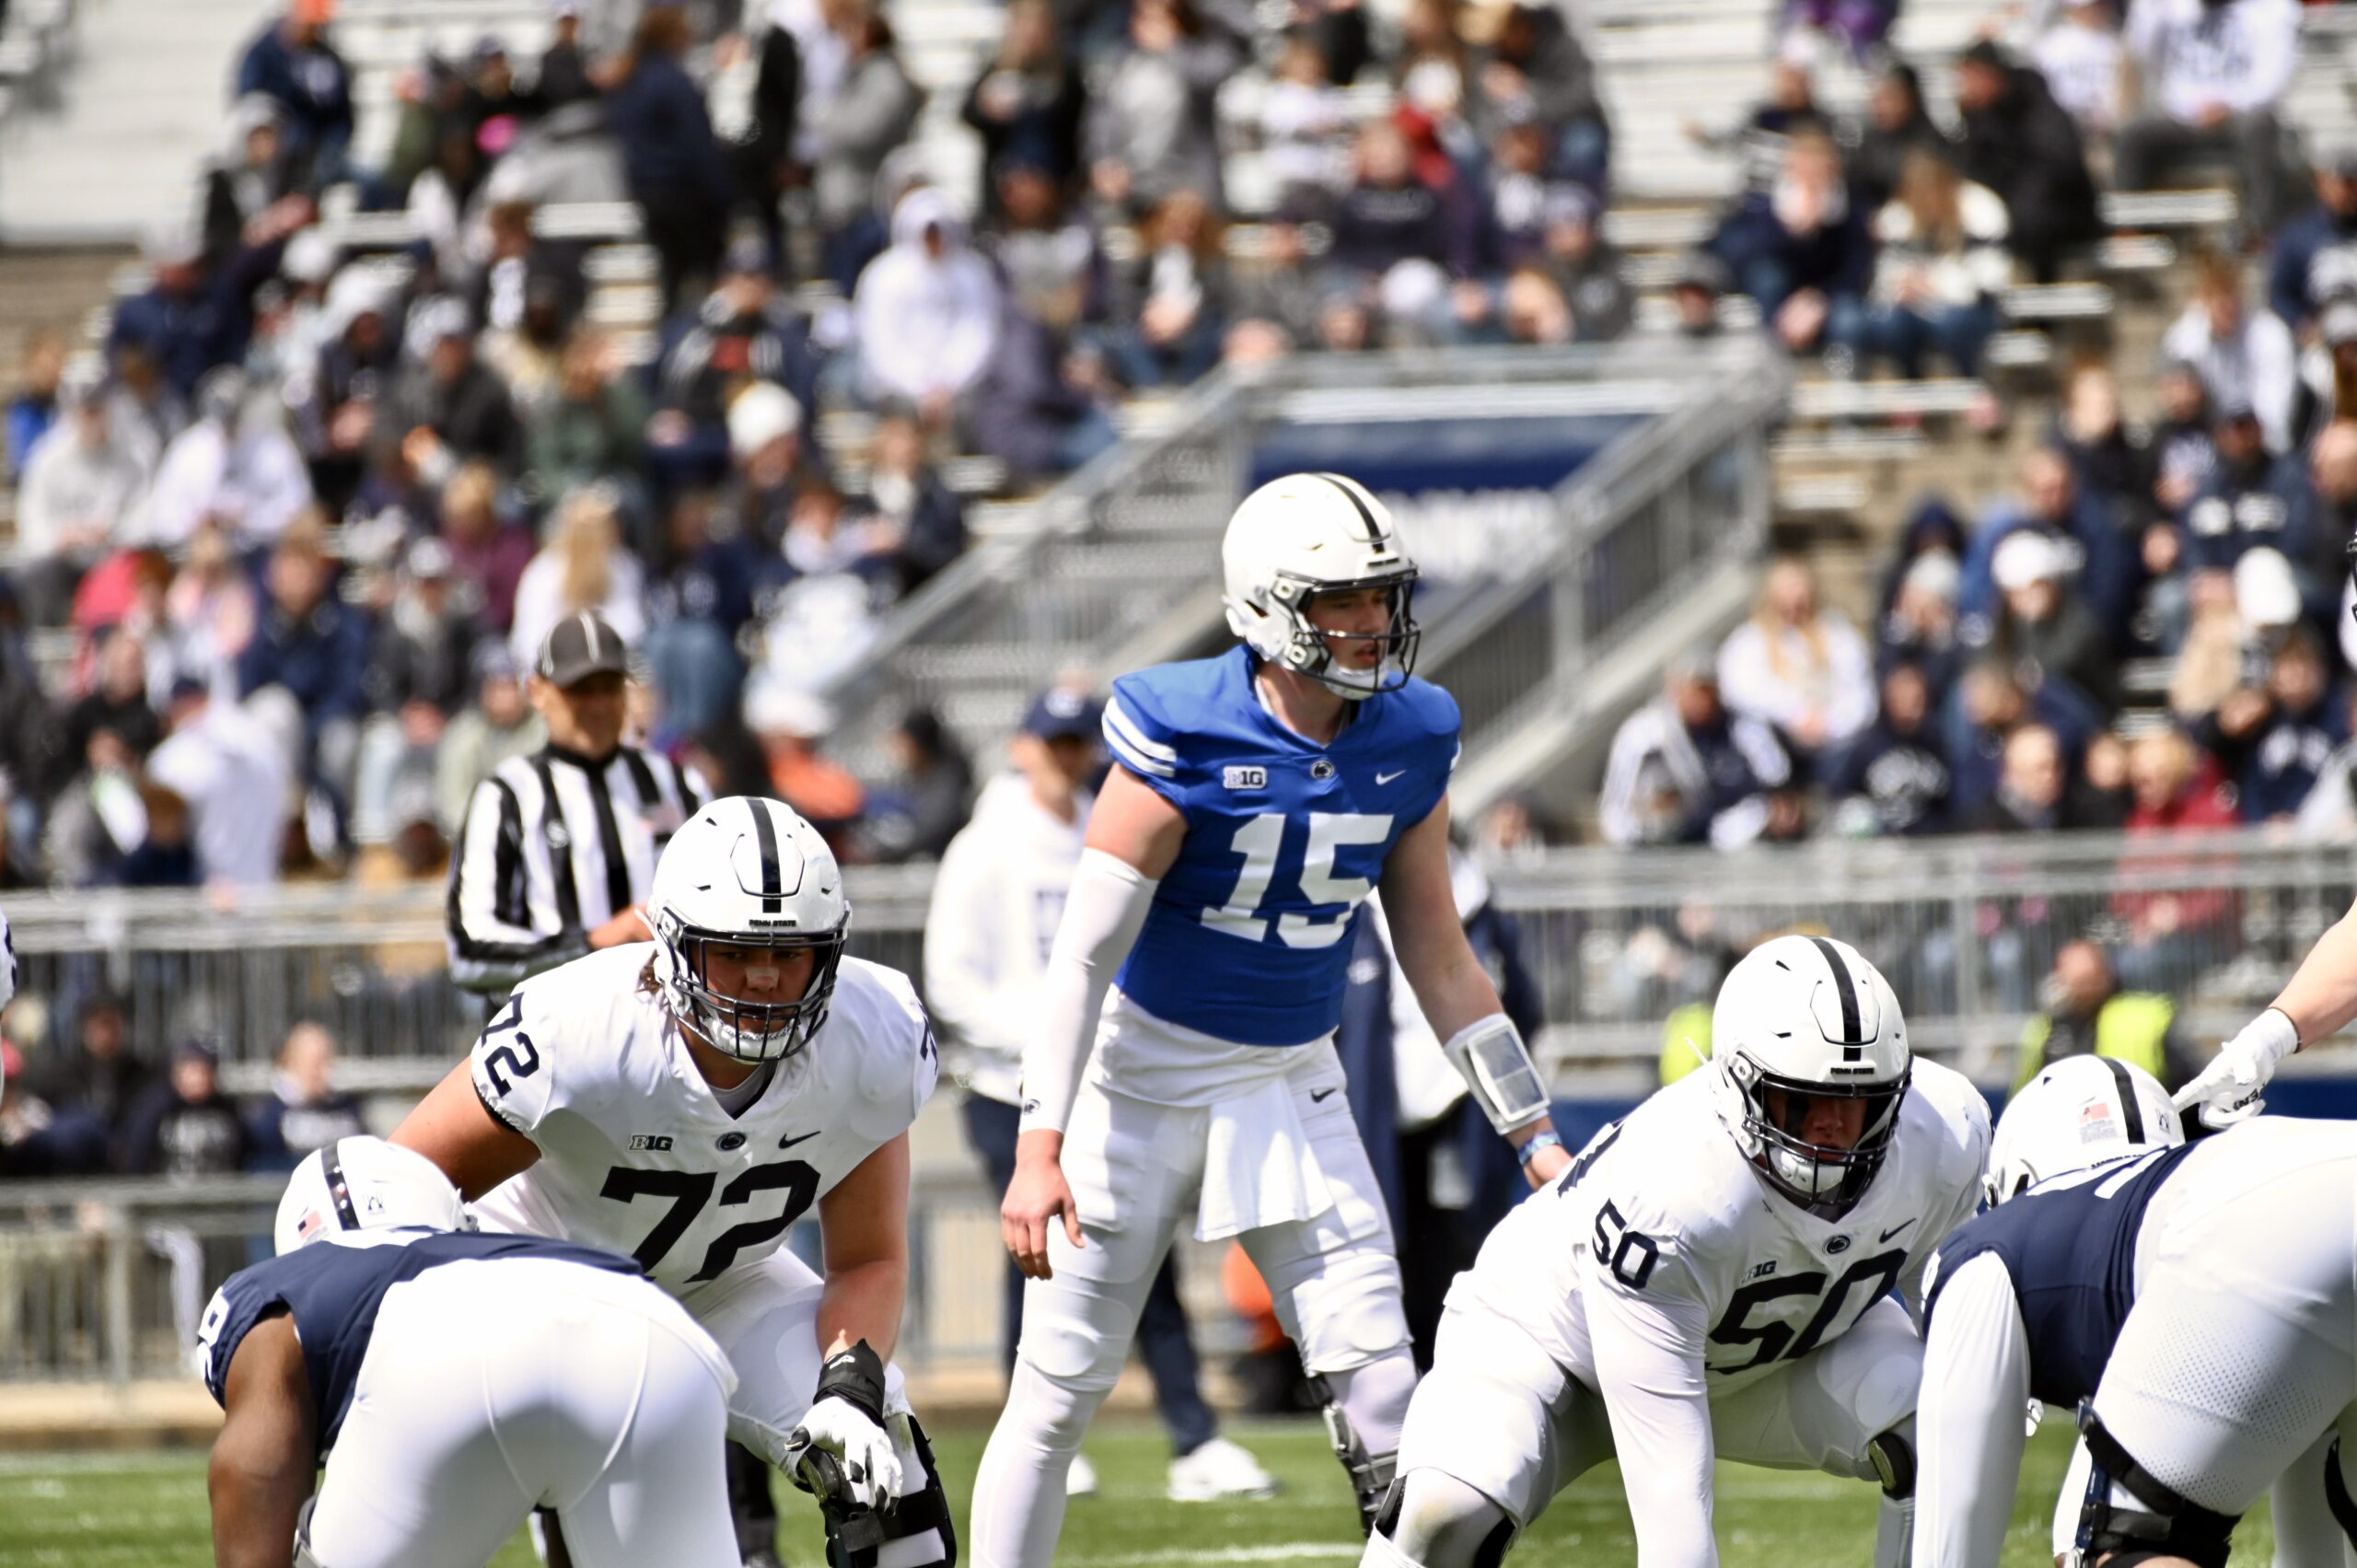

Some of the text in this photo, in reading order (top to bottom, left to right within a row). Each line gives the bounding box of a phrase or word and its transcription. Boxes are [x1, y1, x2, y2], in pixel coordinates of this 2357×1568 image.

[749, 919, 796, 927] PENN STATE
[1201, 812, 1395, 949] 15
[481, 991, 540, 1098] 72
[599, 1160, 821, 1283] 72
[1592, 1197, 1660, 1289] 50
[1704, 1248, 1909, 1375] 50
